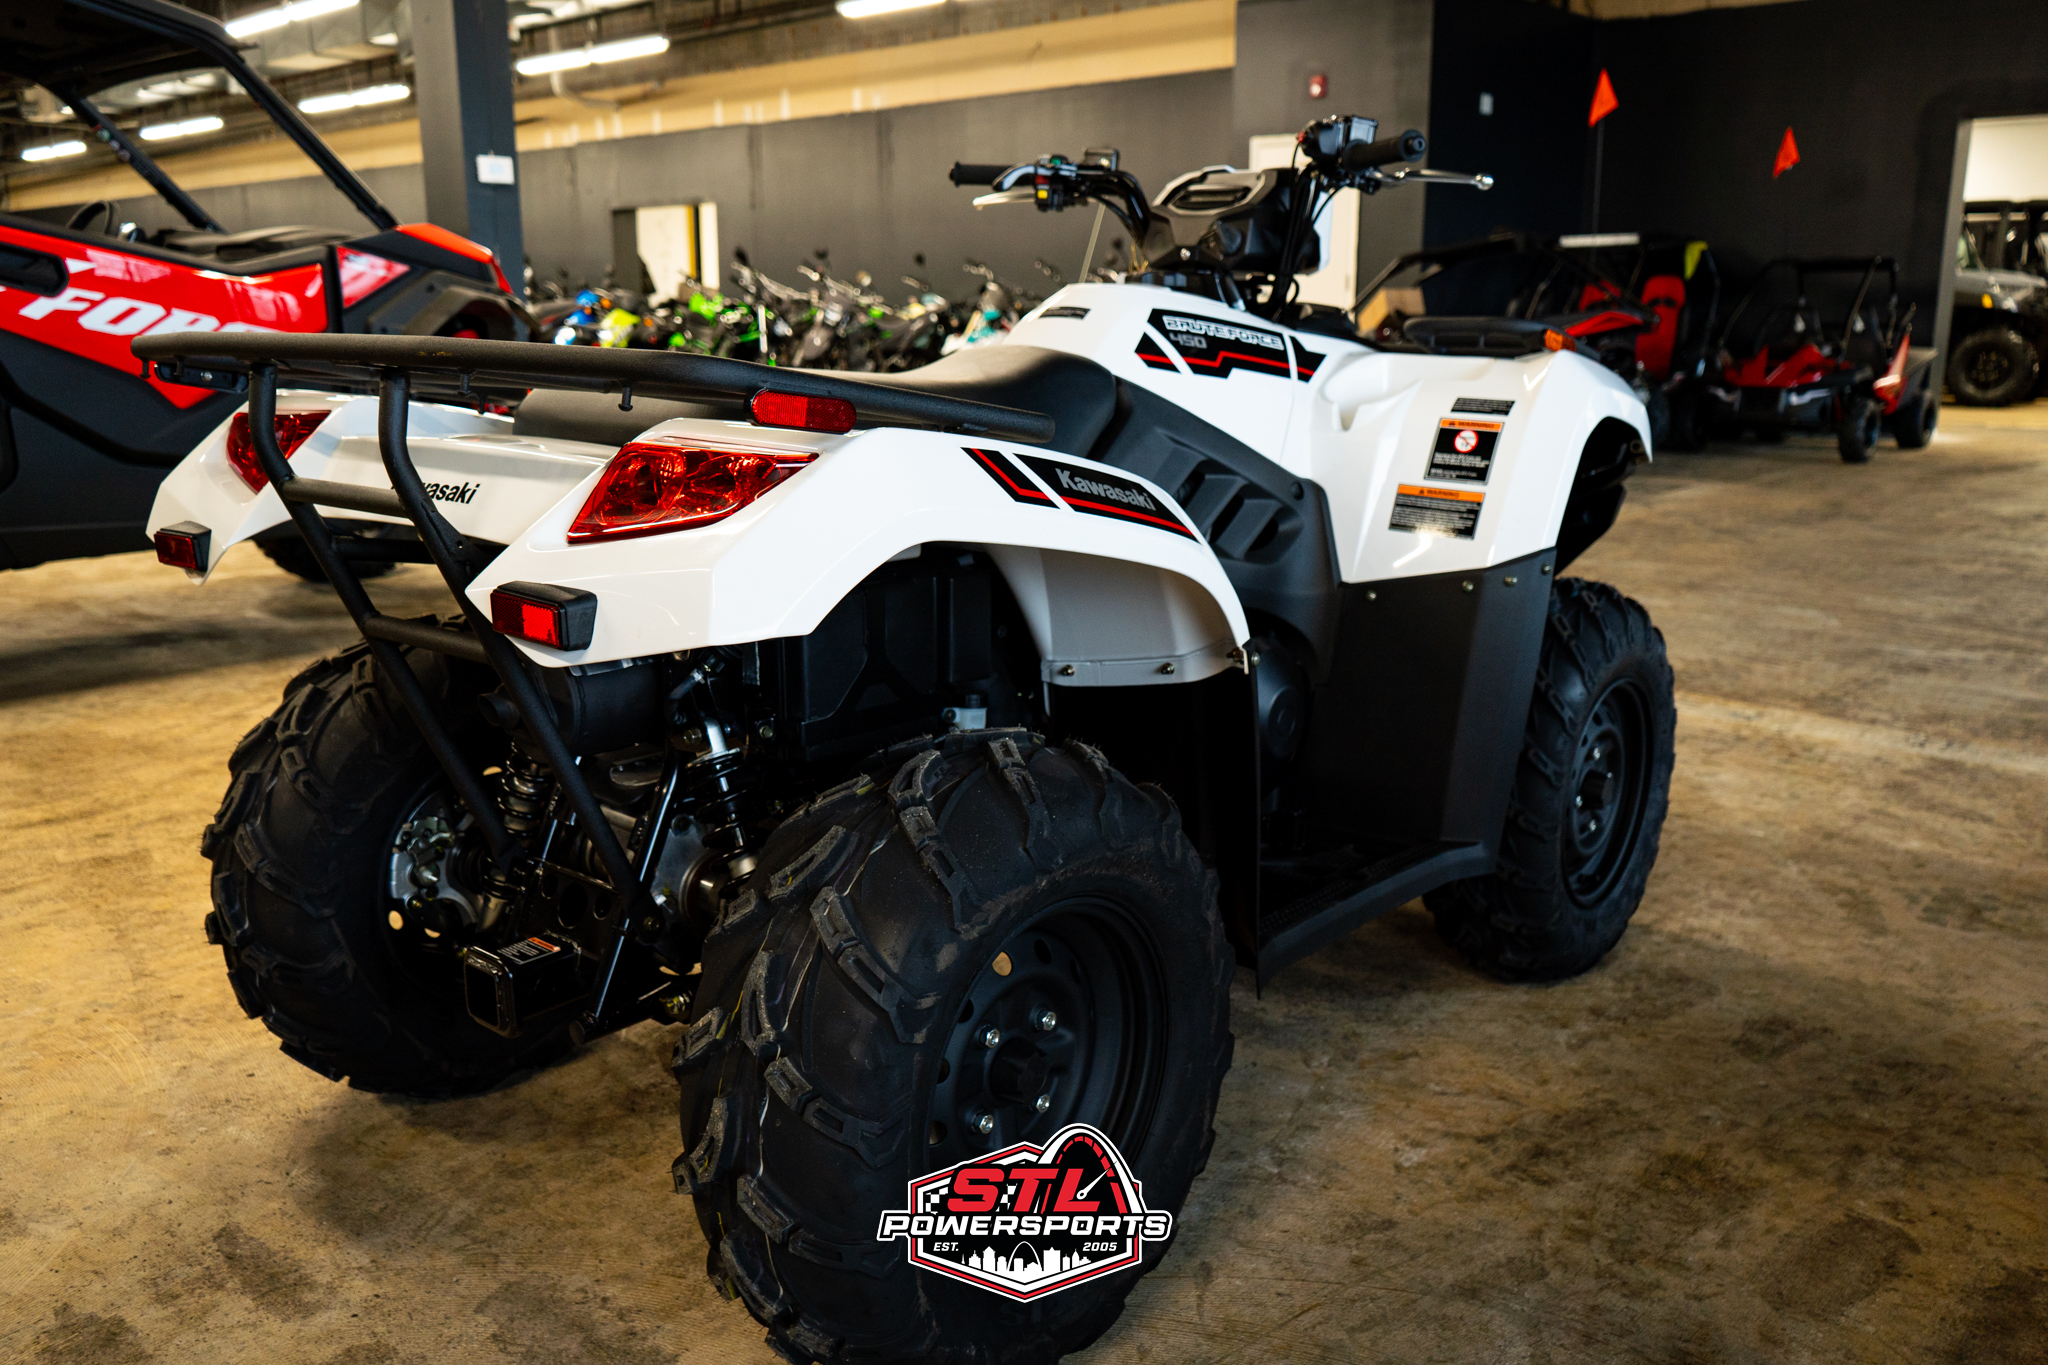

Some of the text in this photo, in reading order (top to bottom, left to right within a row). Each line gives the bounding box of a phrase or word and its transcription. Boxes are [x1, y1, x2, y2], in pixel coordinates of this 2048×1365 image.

[18, 286, 286, 336] FOR
[1169, 332, 1208, 349] 450
[1458, 421, 1495, 429] WARNING
[391, 481, 481, 504] asaki
[1055, 467, 1157, 512] Kawasaki
[1426, 489, 1460, 498] WARNING
